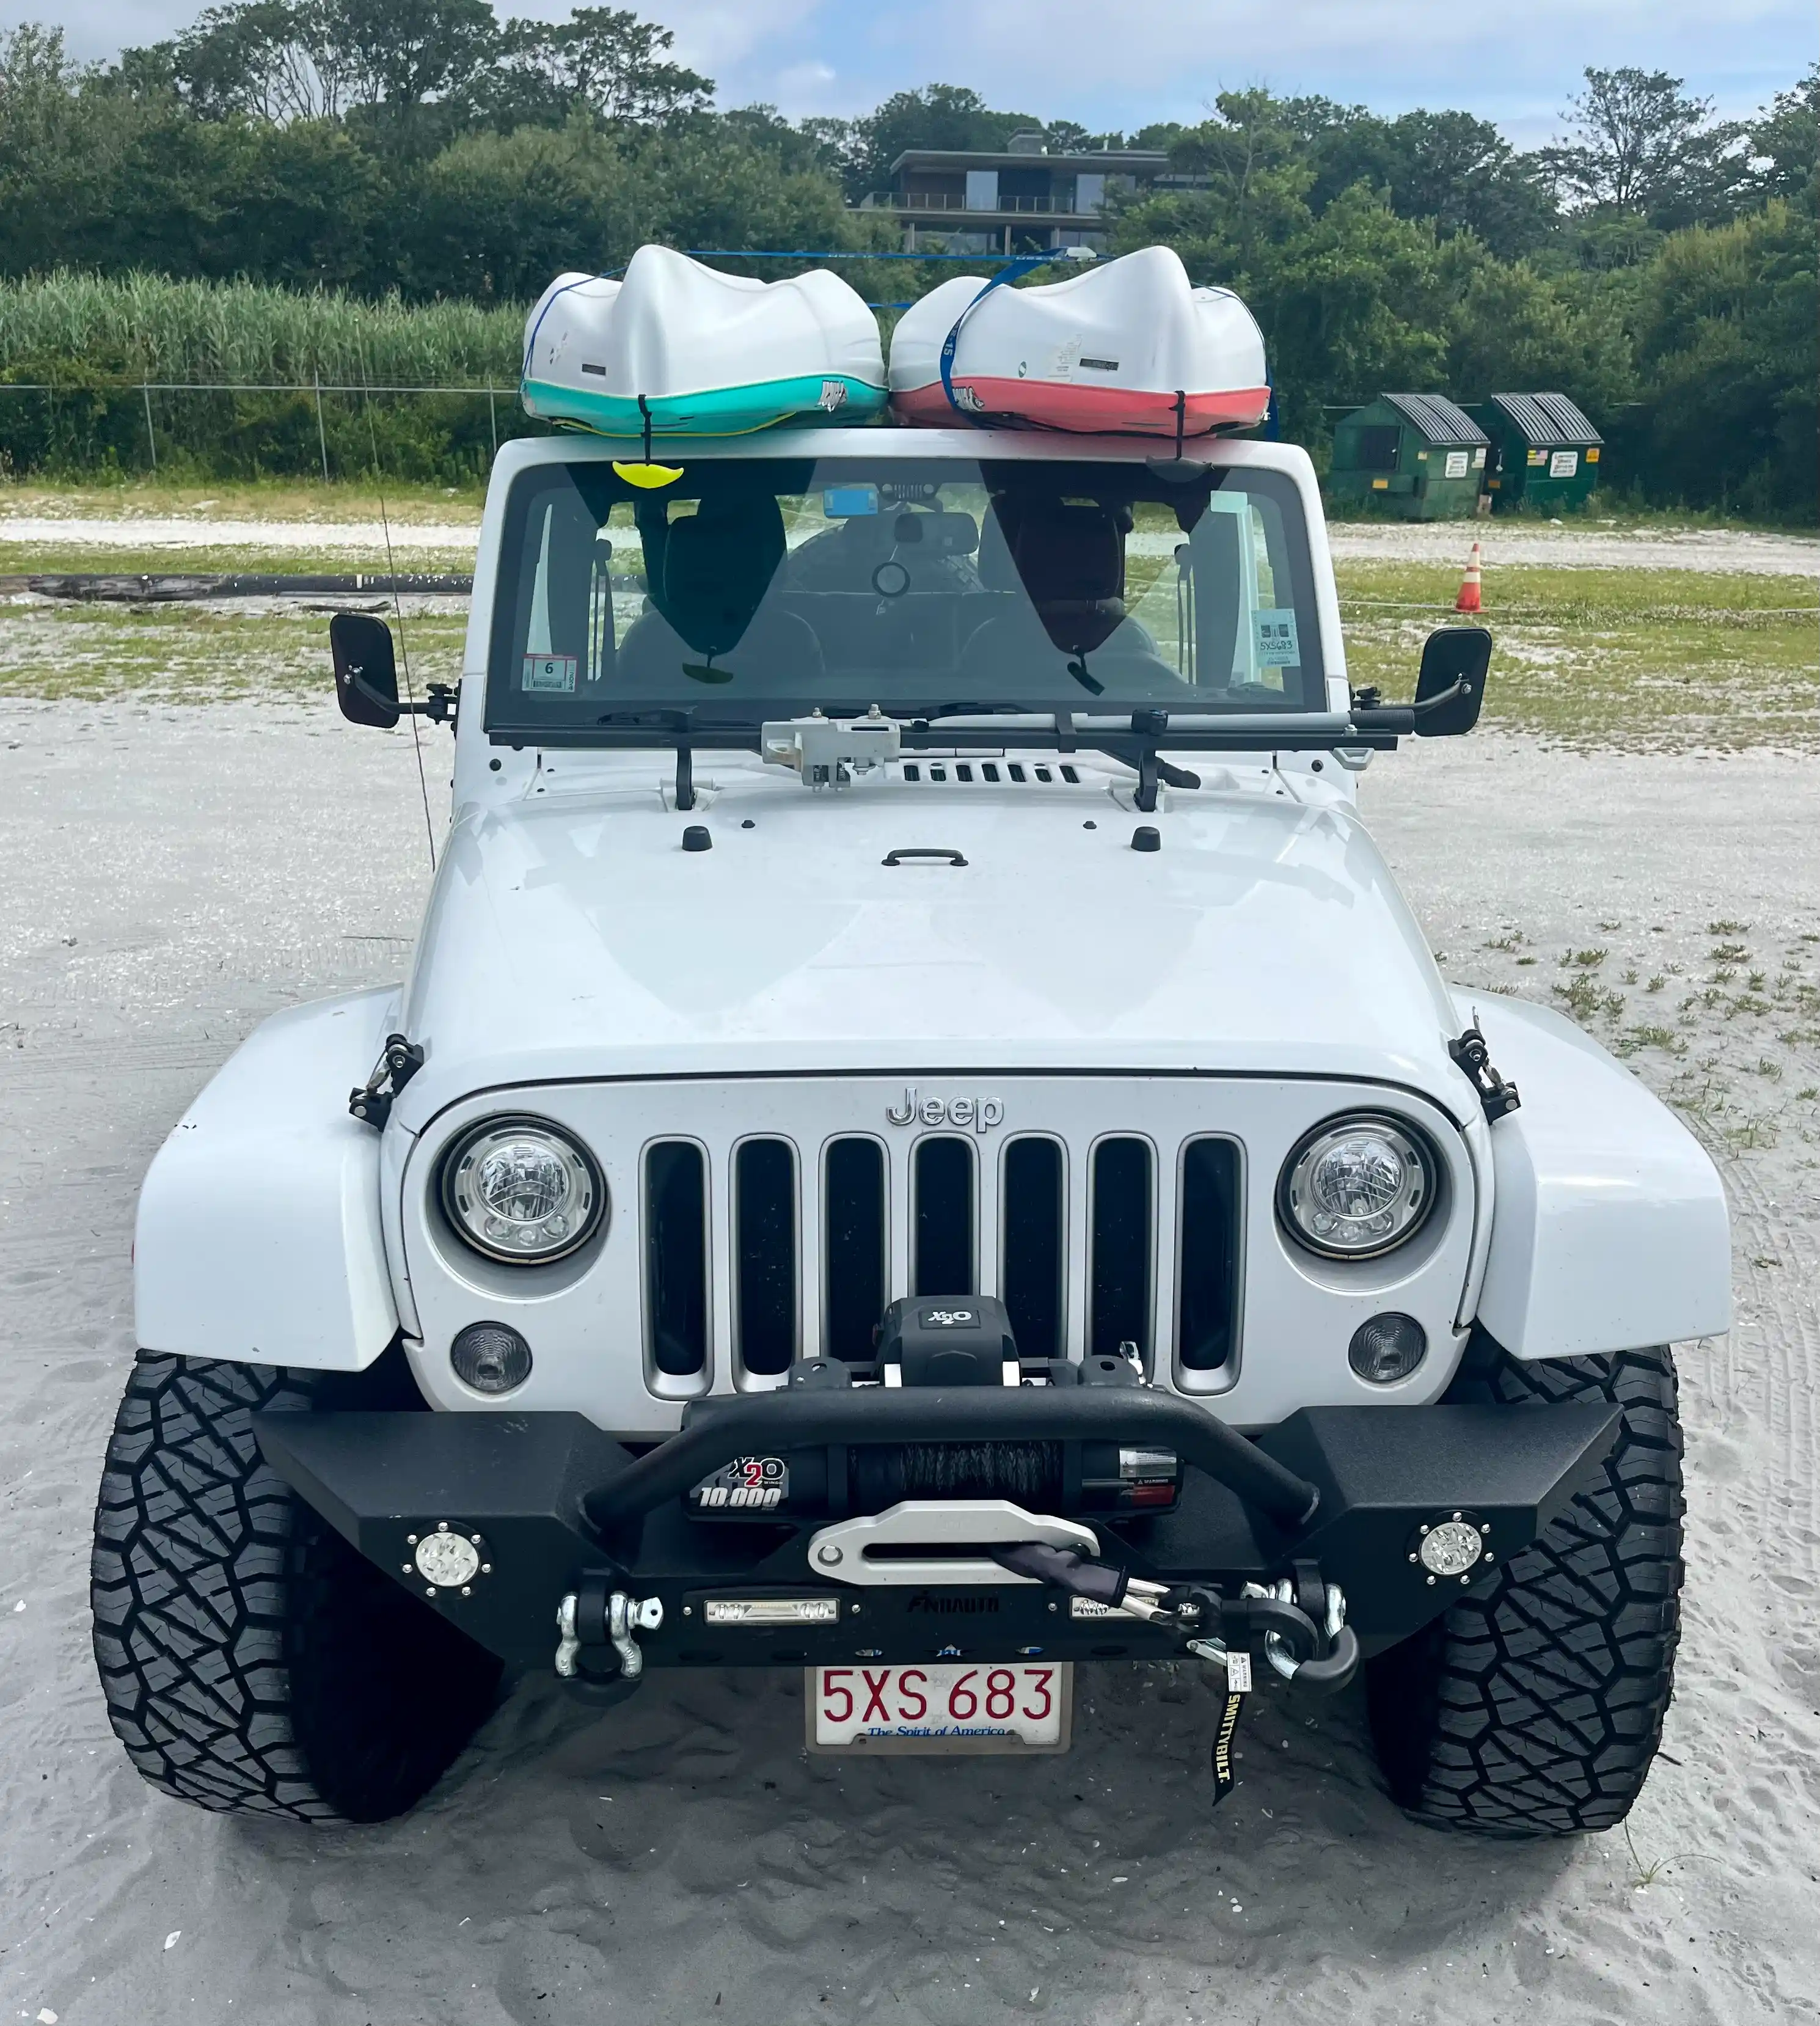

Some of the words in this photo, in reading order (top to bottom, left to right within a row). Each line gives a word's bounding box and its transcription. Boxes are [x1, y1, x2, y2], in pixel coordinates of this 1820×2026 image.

[545, 662, 554, 674] 6
[886, 1087, 1004, 1133] Jeep
[700, 1487, 782, 1508] 10,000
[823, 1669, 927, 1722] 5XS
[948, 1669, 1053, 1720] 683
[868, 1727, 893, 1736] The
[934, 1725, 948, 1736] of
[951, 1725, 1006, 1736] America
[1216, 1694, 1241, 1781] SMITTYBILT
